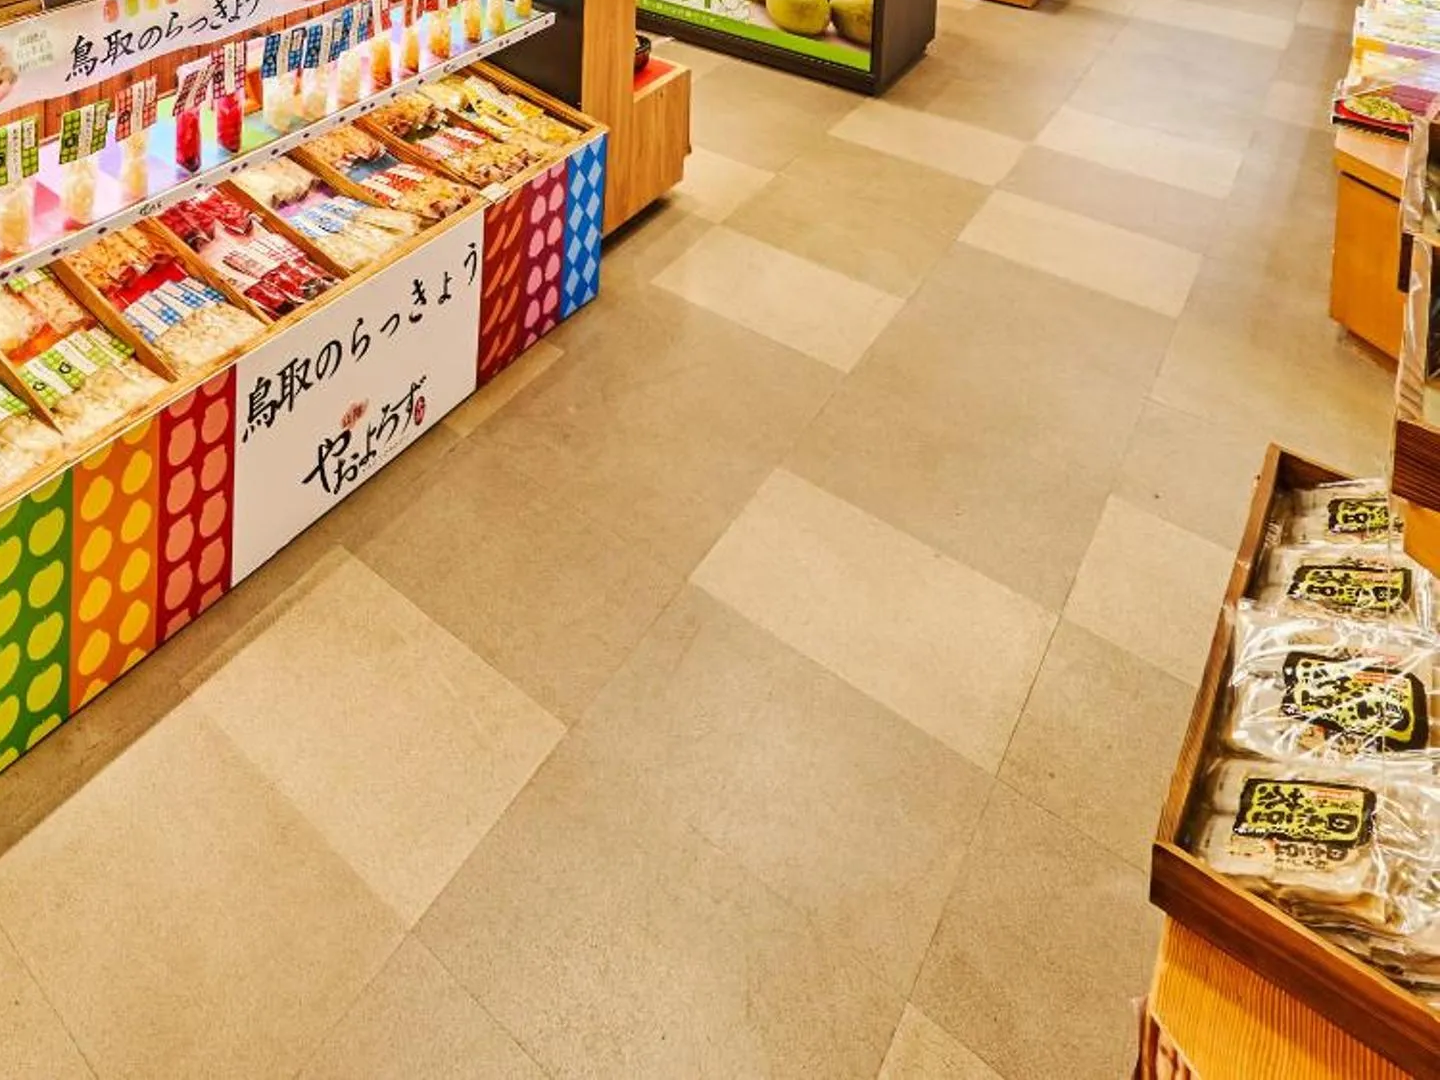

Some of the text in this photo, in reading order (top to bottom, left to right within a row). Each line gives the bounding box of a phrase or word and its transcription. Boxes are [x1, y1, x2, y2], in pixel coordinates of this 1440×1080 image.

[241, 242, 478, 443] 鳥取のらっきょう
